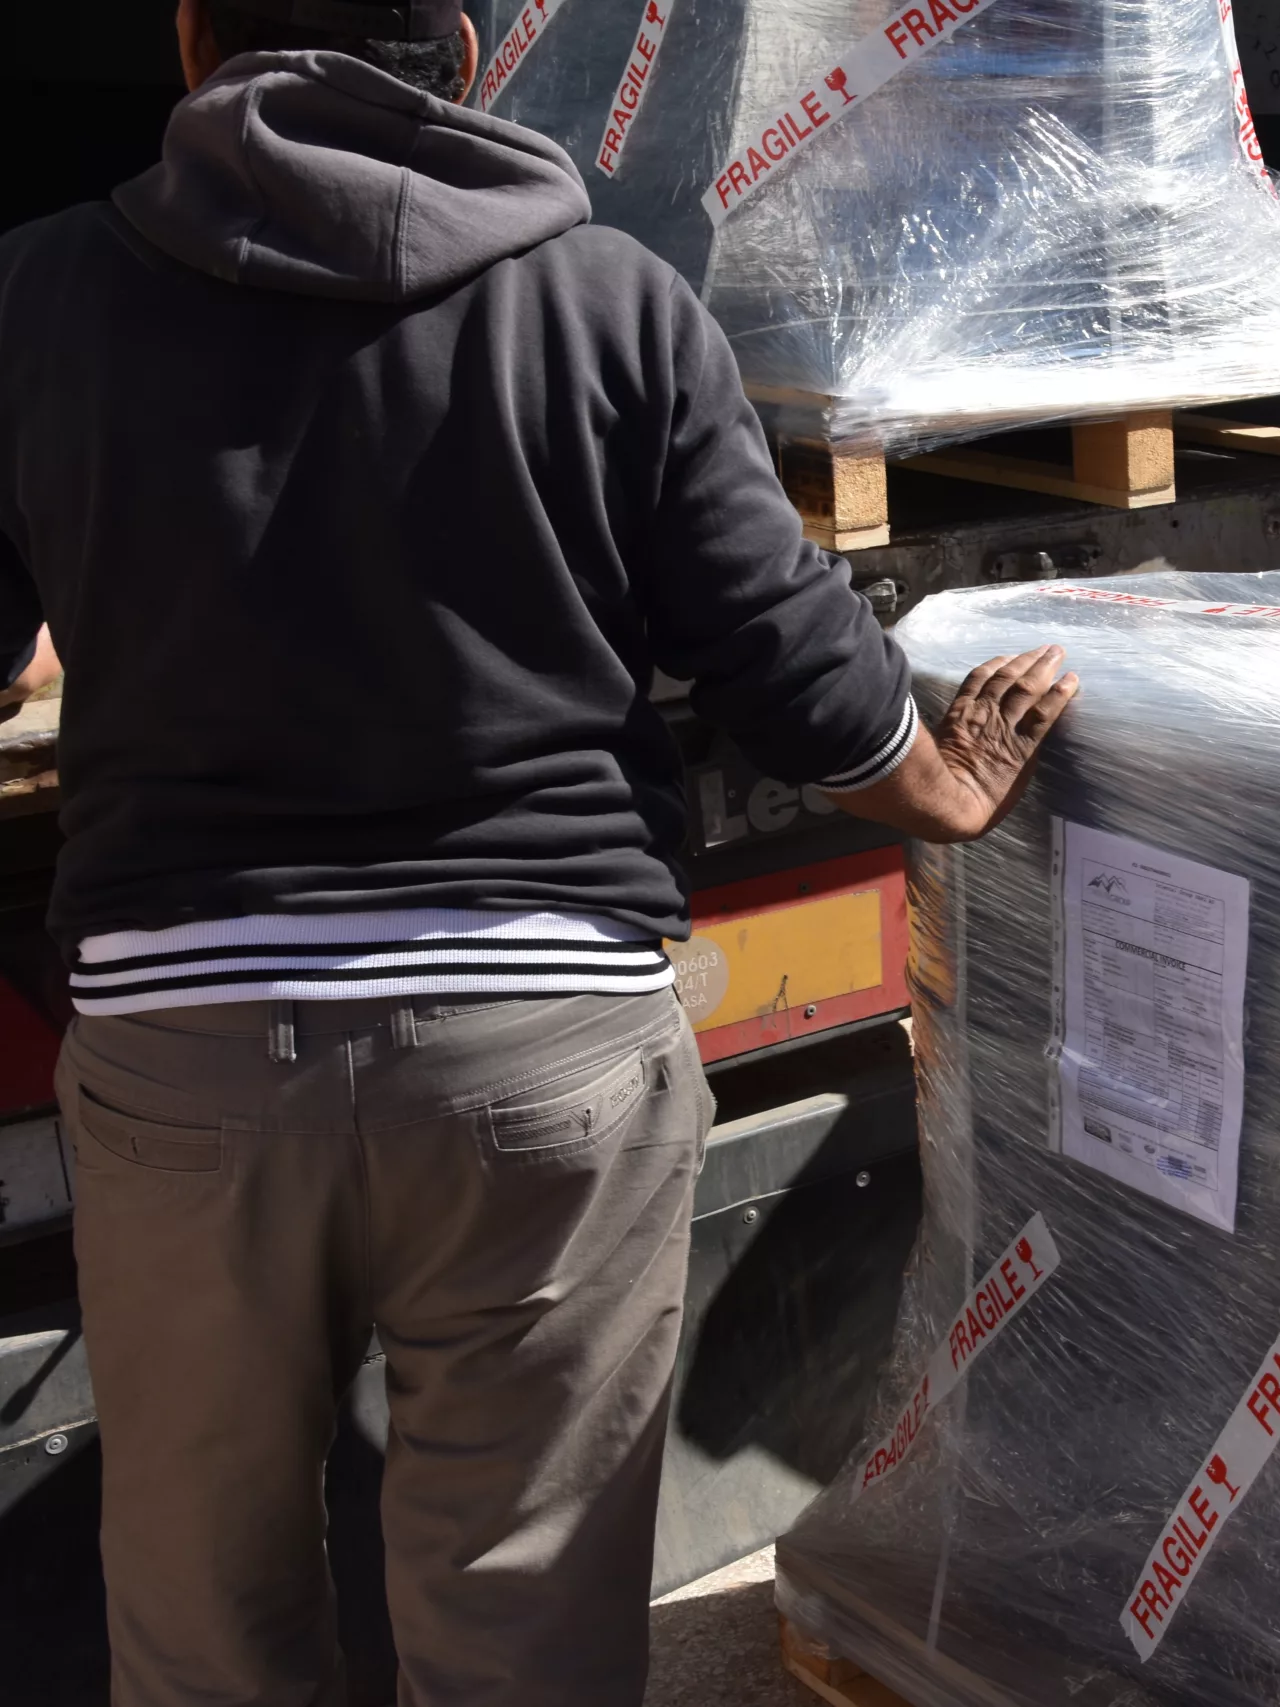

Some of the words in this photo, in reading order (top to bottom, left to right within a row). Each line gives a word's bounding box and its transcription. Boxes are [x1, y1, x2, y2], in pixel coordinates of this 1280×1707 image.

[480, 8, 537, 112] FRAGILE
[599, 32, 656, 172] FRAGILE
[715, 90, 830, 209] FRAGILE
[1115, 939, 1159, 963] COMMERCIAL
[1159, 954, 1186, 972] INVOICE
[949, 1257, 1027, 1372] FRAGILE
[1128, 1484, 1220, 1640] FRAGILE
